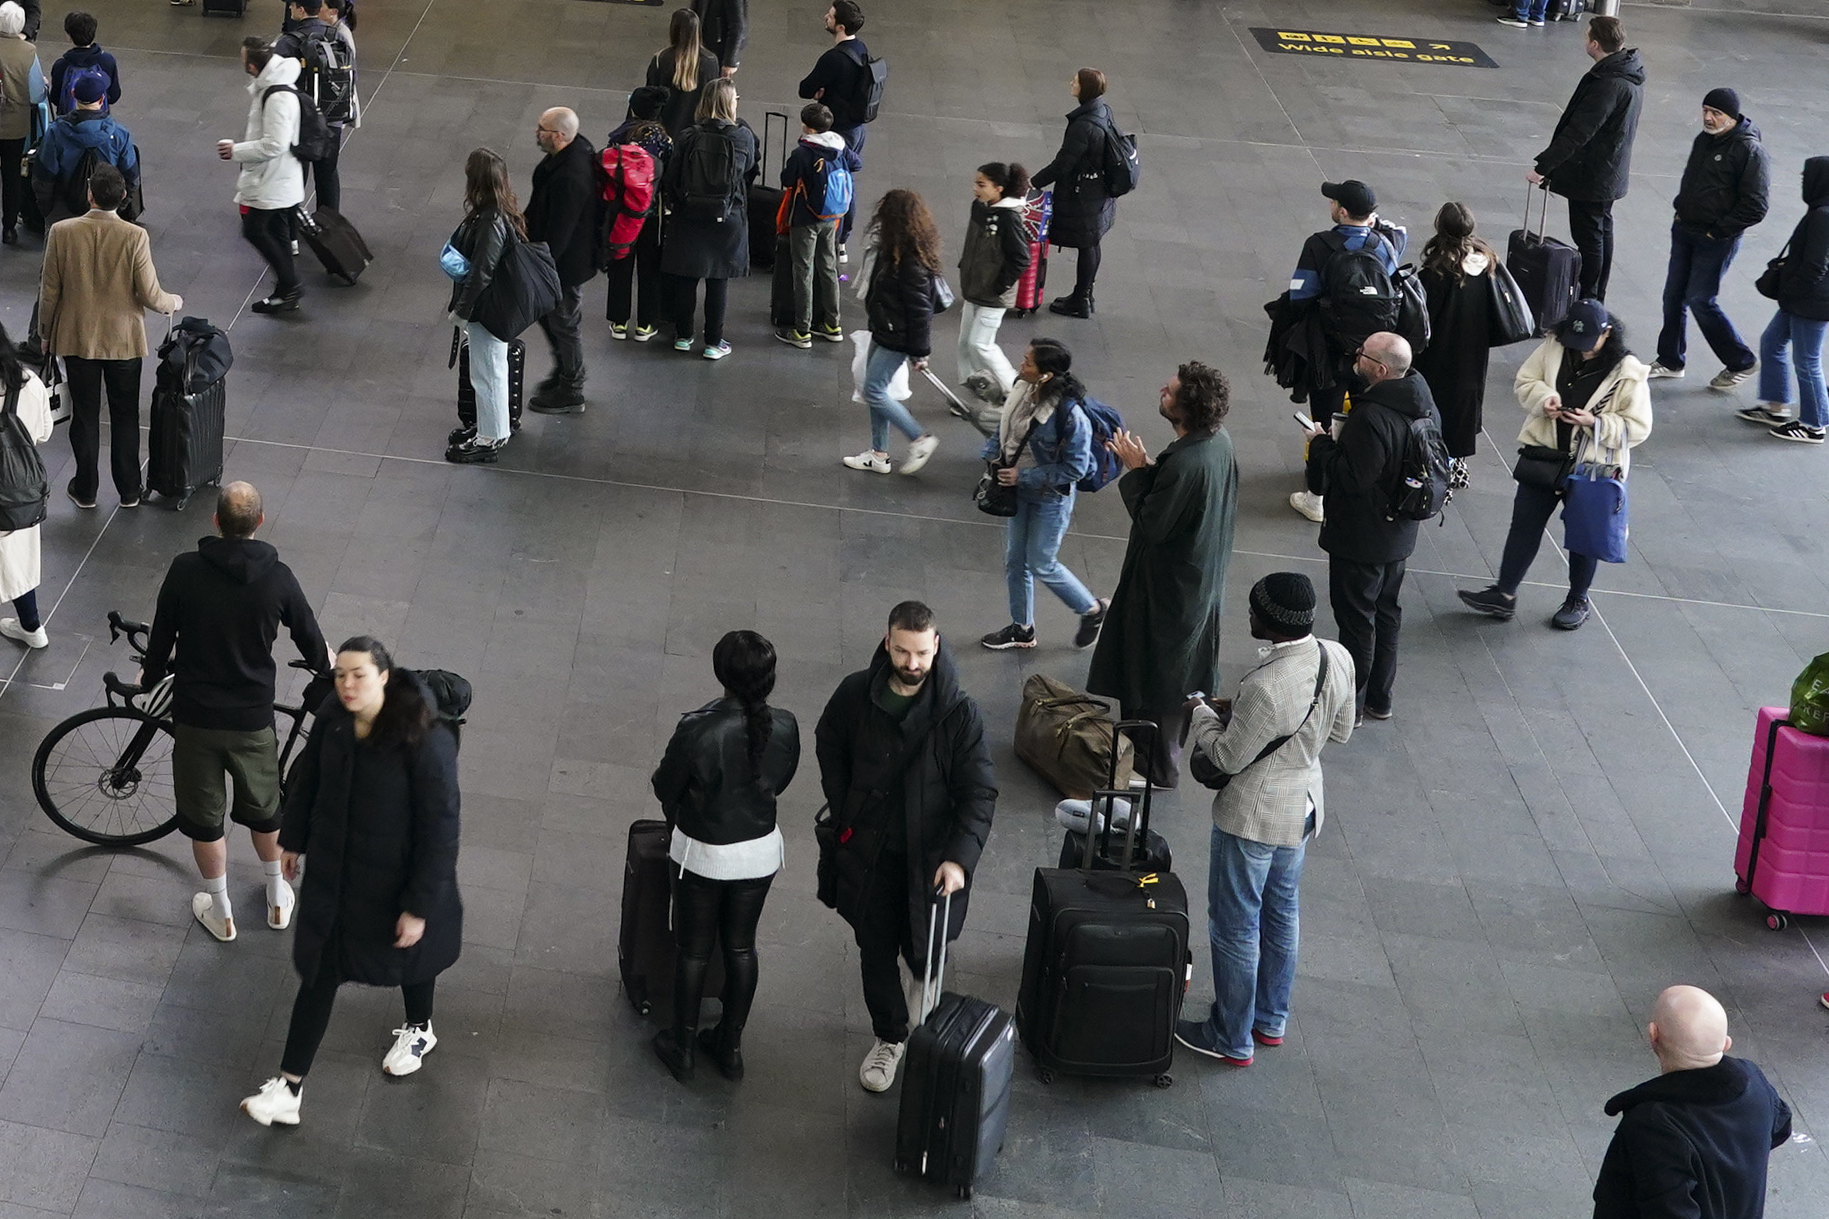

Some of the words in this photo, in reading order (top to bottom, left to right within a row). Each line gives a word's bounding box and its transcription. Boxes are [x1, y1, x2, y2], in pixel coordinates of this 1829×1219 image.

[1278, 43, 1344, 54] Wide
[1352, 49, 1408, 58] aisle
[1416, 54, 1474, 63] gate
